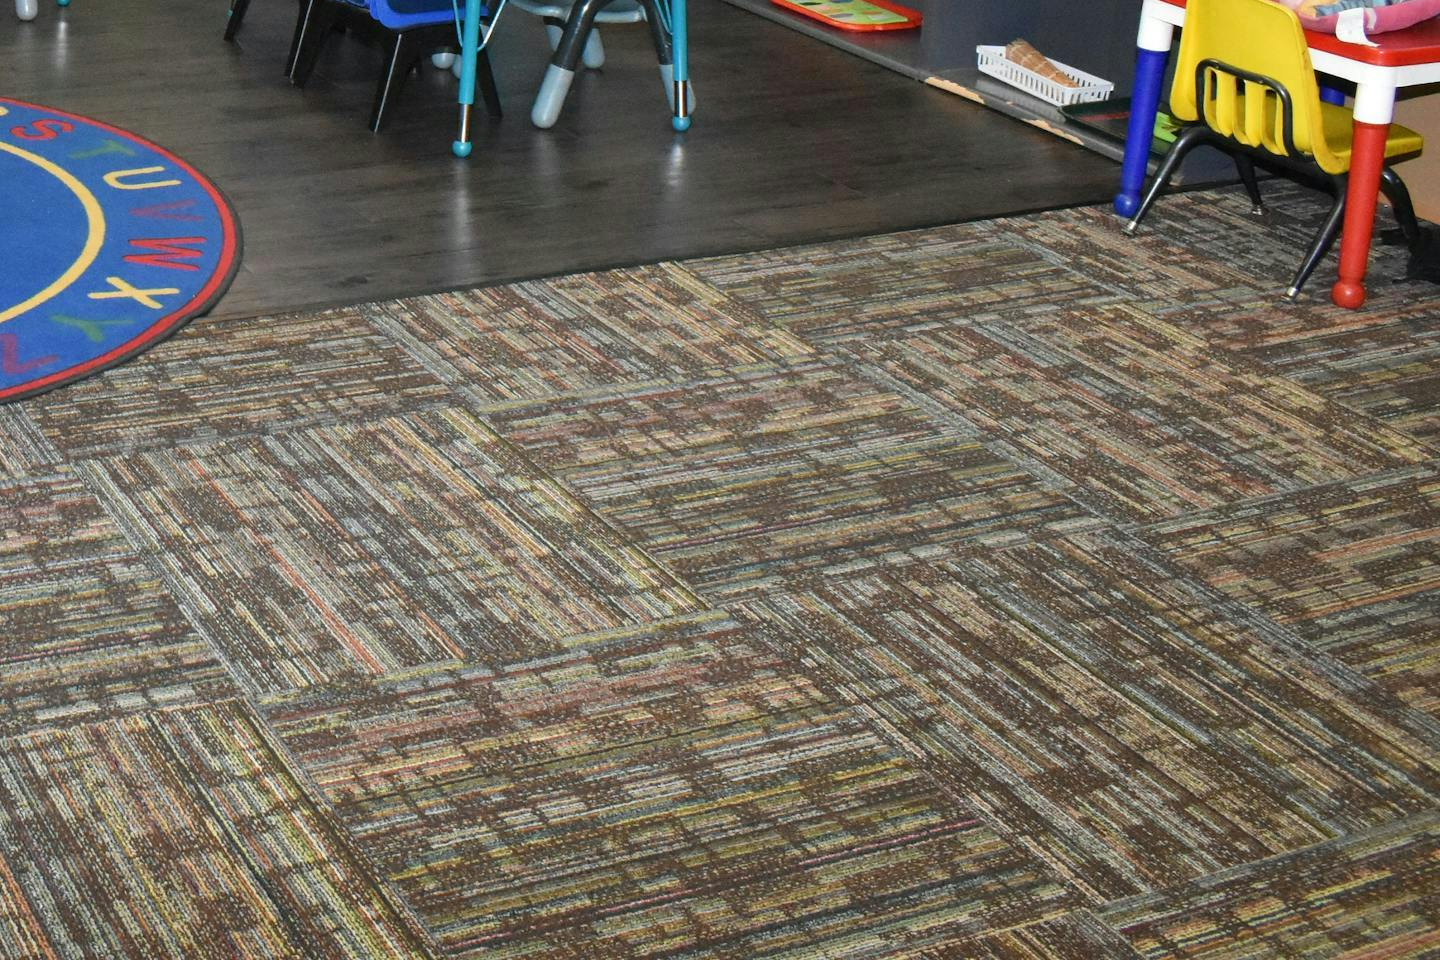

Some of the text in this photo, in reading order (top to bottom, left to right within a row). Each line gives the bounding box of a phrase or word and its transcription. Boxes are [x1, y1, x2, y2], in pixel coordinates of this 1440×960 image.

[9, 118, 76, 142] S
[64, 139, 138, 160] T
[103, 166, 183, 190] U
[127, 199, 205, 222] V
[122, 236, 209, 272] W
[86, 276, 181, 310] X
[50, 313, 137, 344] Y
